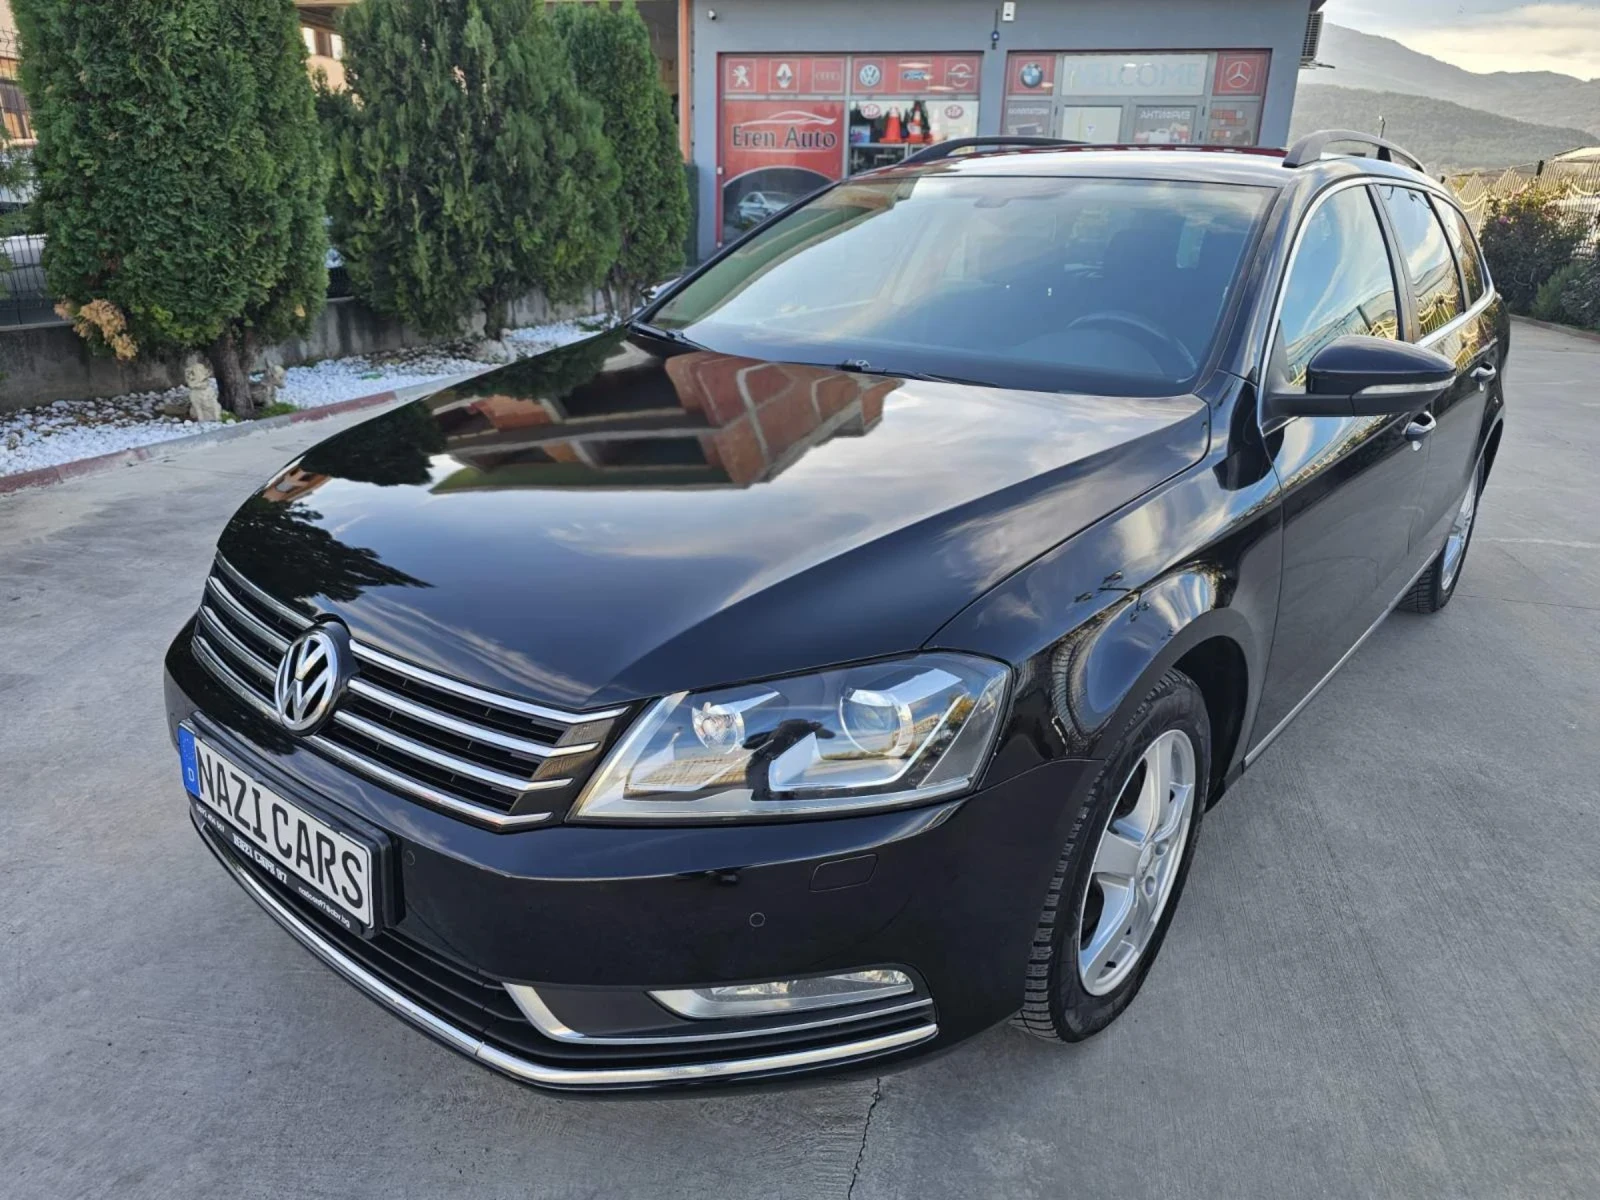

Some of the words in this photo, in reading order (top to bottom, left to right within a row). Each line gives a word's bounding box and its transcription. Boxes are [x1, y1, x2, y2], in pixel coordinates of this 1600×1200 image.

[1069, 62, 1201, 88] WELCOME
[732, 125, 776, 148] Eren
[784, 126, 837, 149] Auto
[187, 767, 195, 782] D
[196, 746, 268, 843] NAZI
[272, 803, 364, 909] CARS
